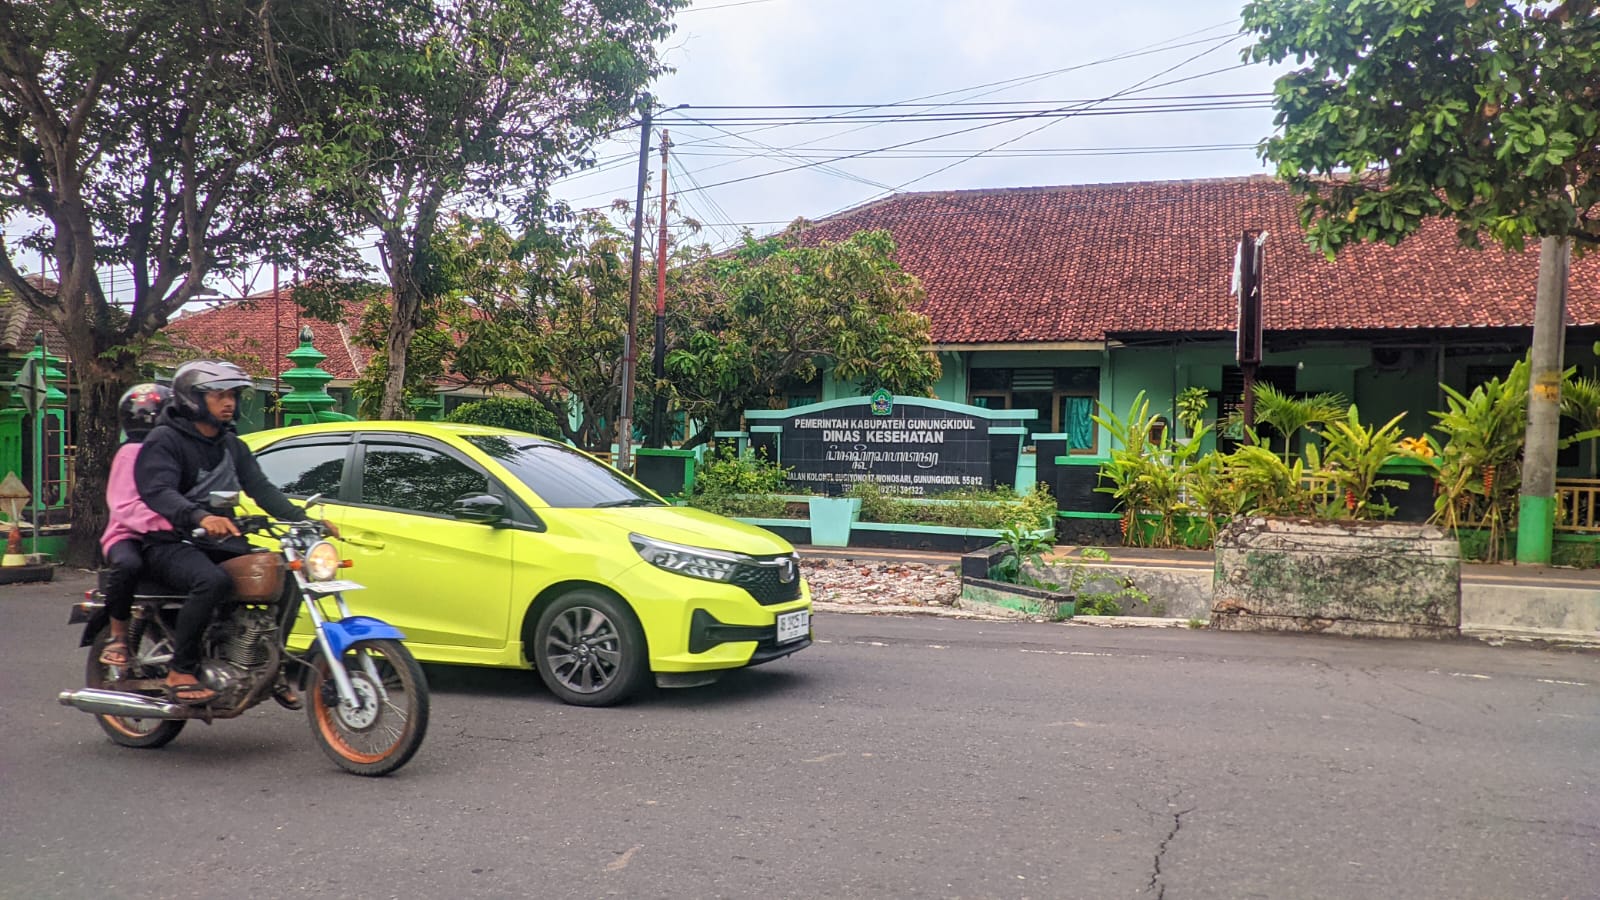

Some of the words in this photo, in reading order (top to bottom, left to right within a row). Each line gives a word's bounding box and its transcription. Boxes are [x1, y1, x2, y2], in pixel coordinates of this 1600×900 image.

[794, 418, 849, 429] PEMERINTAH
[850, 419, 905, 430] KABUPATEN
[907, 419, 975, 430] GUNUNGKIDUL
[823, 430, 860, 442] DINAS
[866, 430, 944, 443] KESEHATAN
[787, 472, 806, 481] JALAN
[913, 475, 960, 484] GUNUNGKIDUL
[962, 476, 982, 485] 55812
